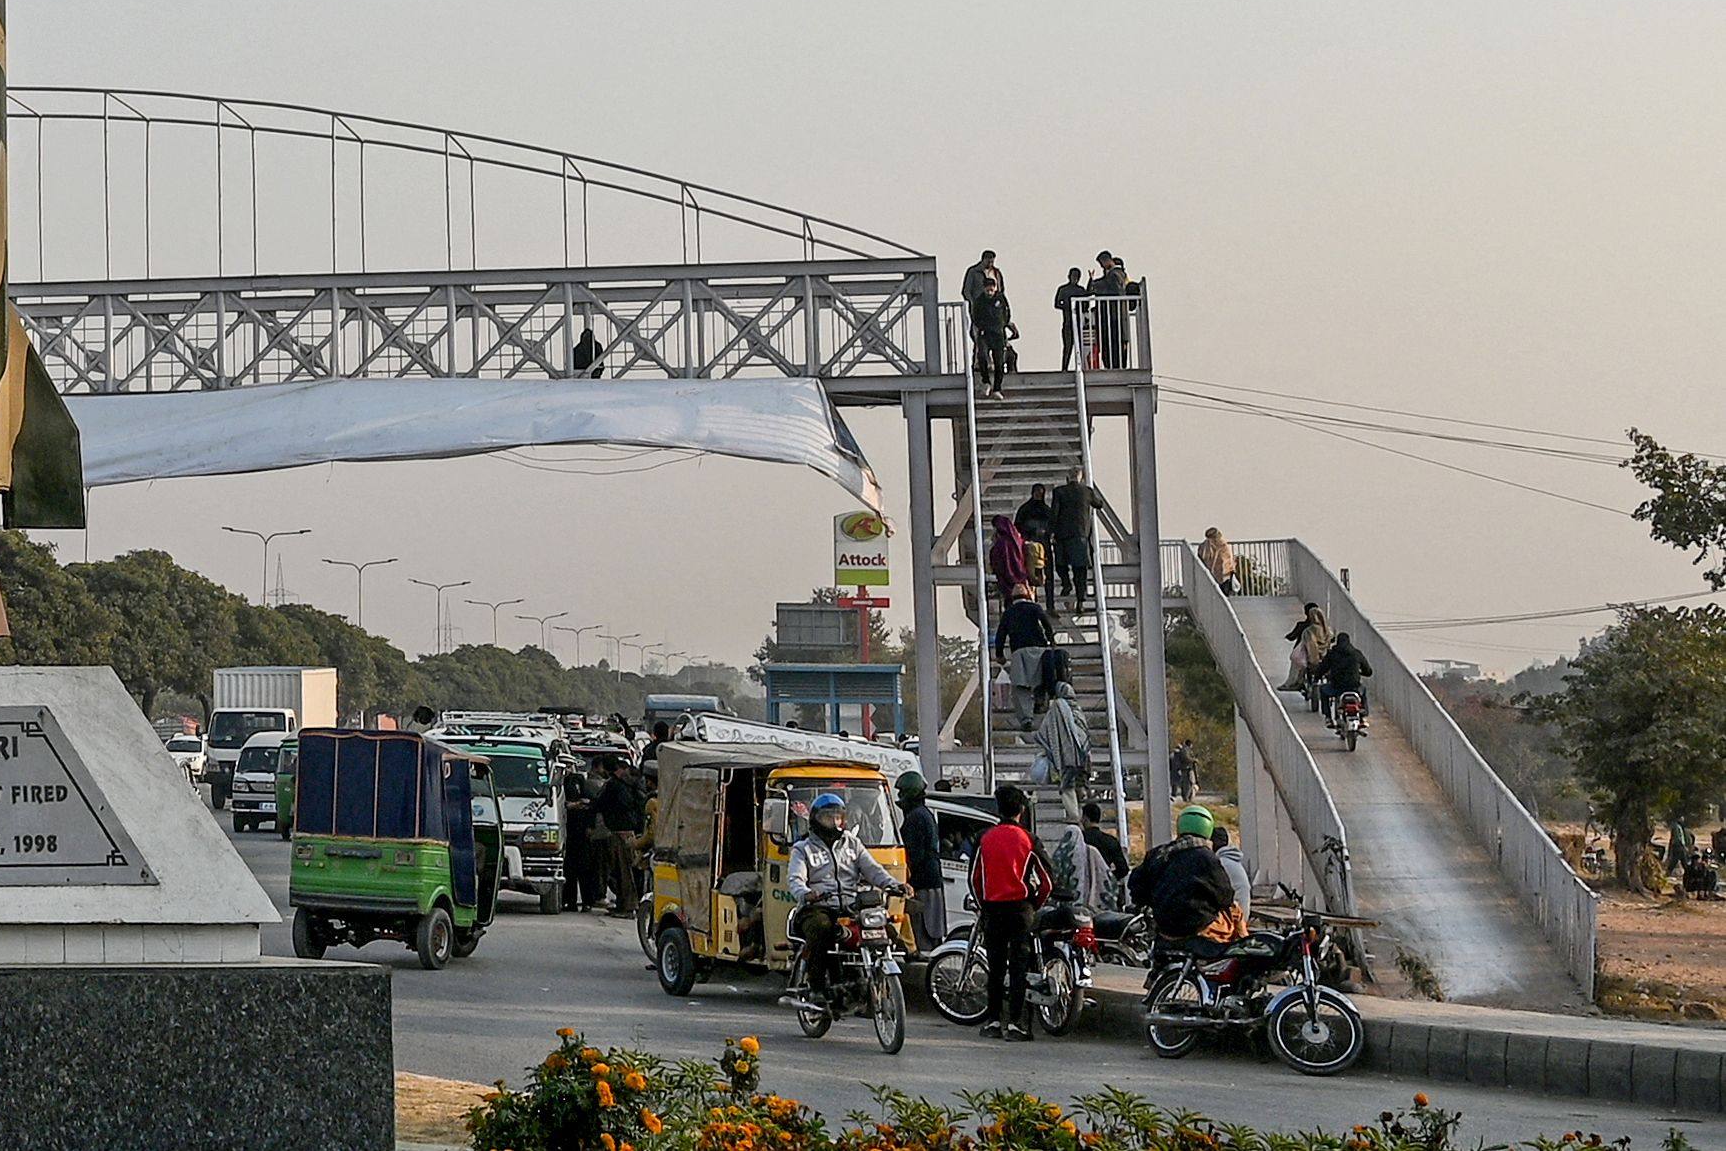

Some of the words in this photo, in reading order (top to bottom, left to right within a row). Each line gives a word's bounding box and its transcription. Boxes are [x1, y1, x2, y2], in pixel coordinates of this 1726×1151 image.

[838, 553, 887, 566] Attock
[11, 784, 69, 805] FIRED
[13, 834, 58, 854] 1998
